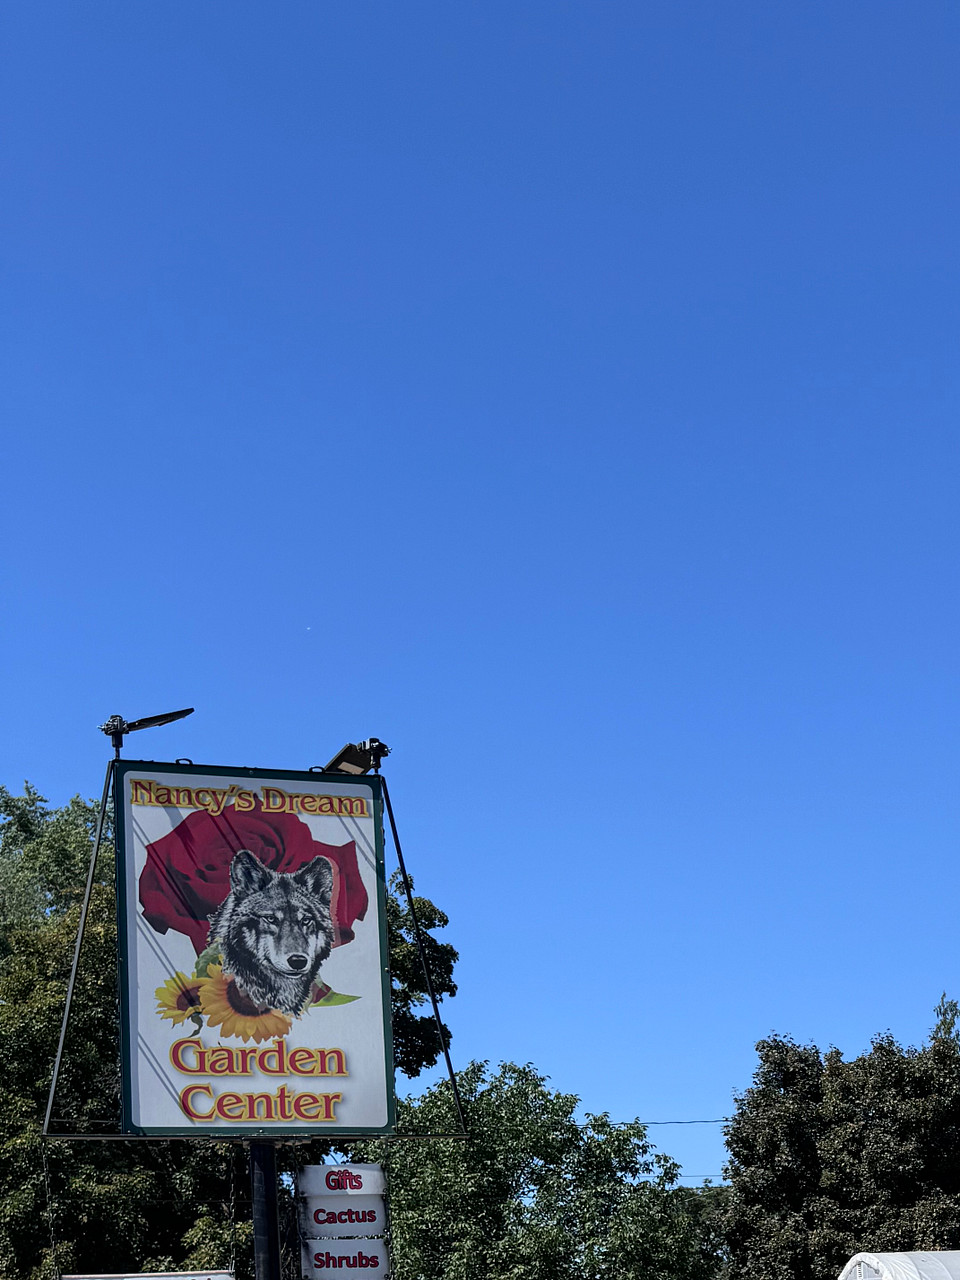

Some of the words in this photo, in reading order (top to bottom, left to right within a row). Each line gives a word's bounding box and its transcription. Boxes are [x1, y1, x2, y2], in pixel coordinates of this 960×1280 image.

[130, 779, 255, 816] Nancy's
[261, 786, 369, 817] Dream
[170, 1037, 348, 1077] Garden
[178, 1084, 342, 1123] Center
[325, 1169, 363, 1190] Gifts
[313, 1208, 377, 1224] Cactus
[314, 1251, 379, 1269] Shrubs
